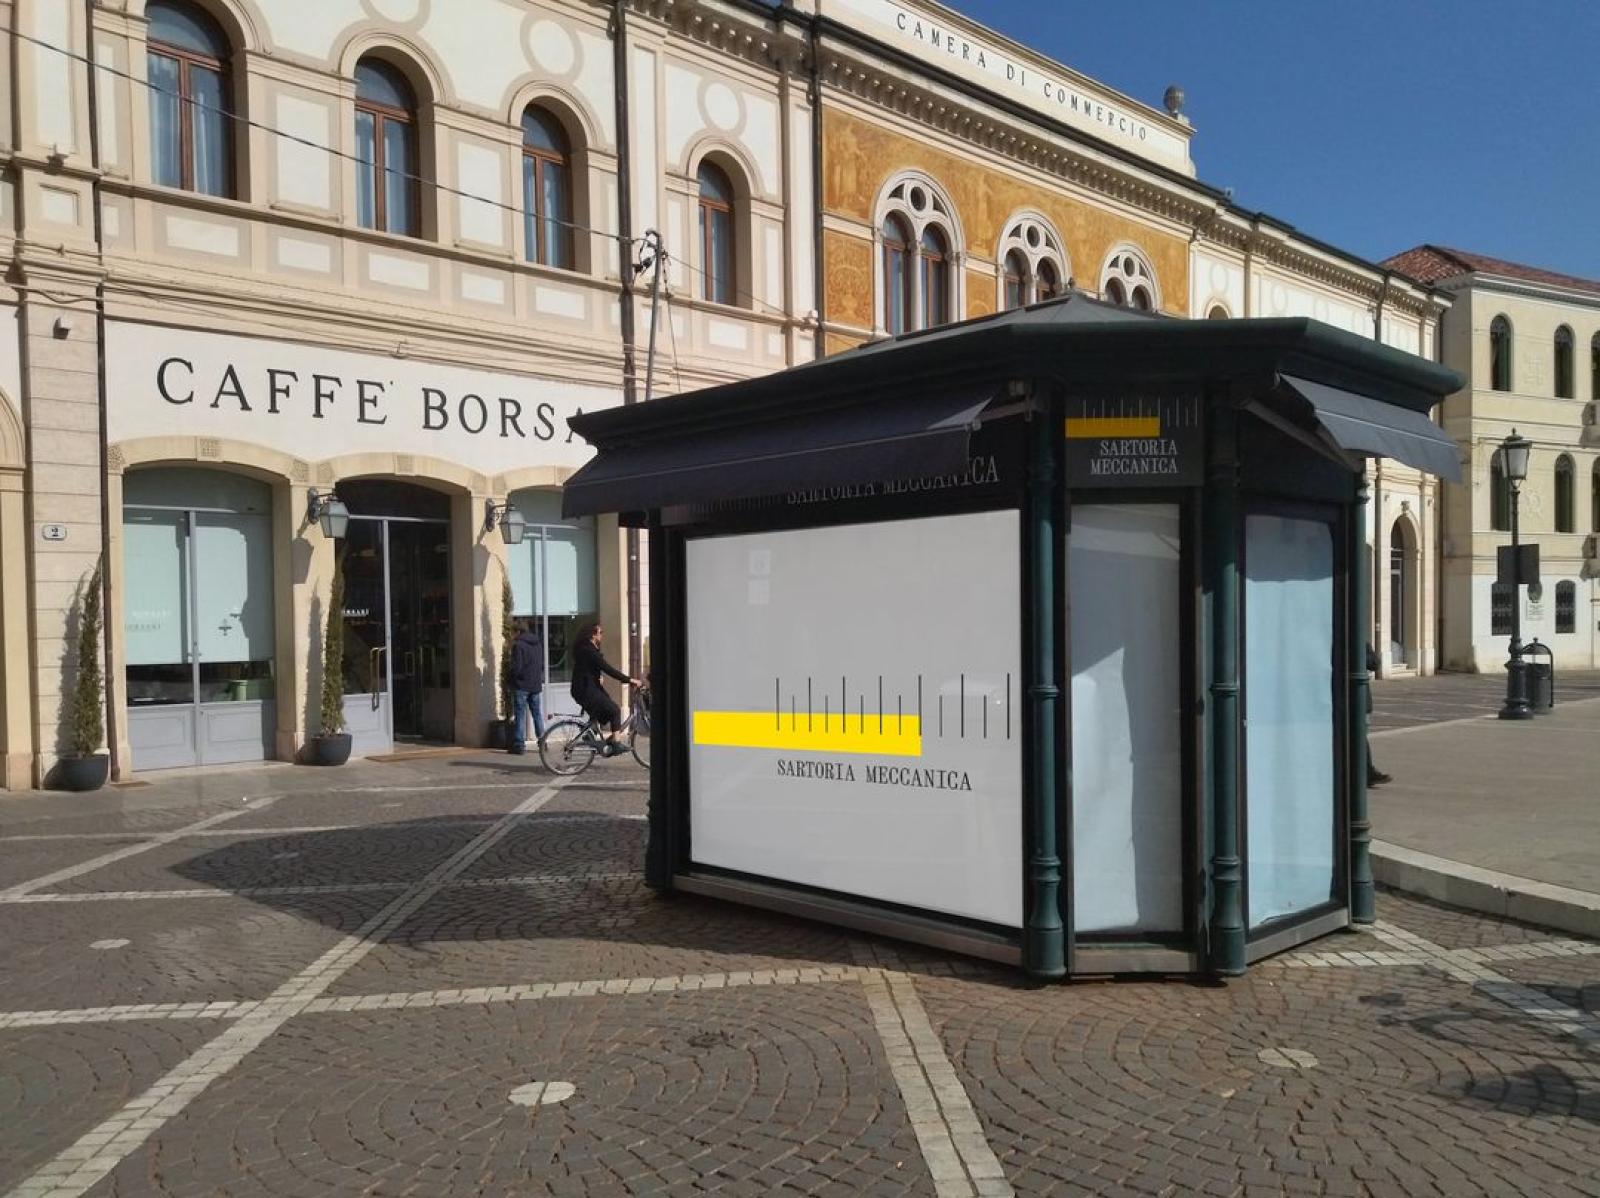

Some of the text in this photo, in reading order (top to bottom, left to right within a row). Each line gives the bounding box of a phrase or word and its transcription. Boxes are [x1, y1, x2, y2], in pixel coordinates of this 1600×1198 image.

[896, 13, 1146, 141] CAMERA DI COMMERCIO
[1099, 438, 1179, 456] SARTORIA
[1090, 457, 1179, 475] MECCANICA
[777, 758, 972, 792] SARTORIA MECCANICA
